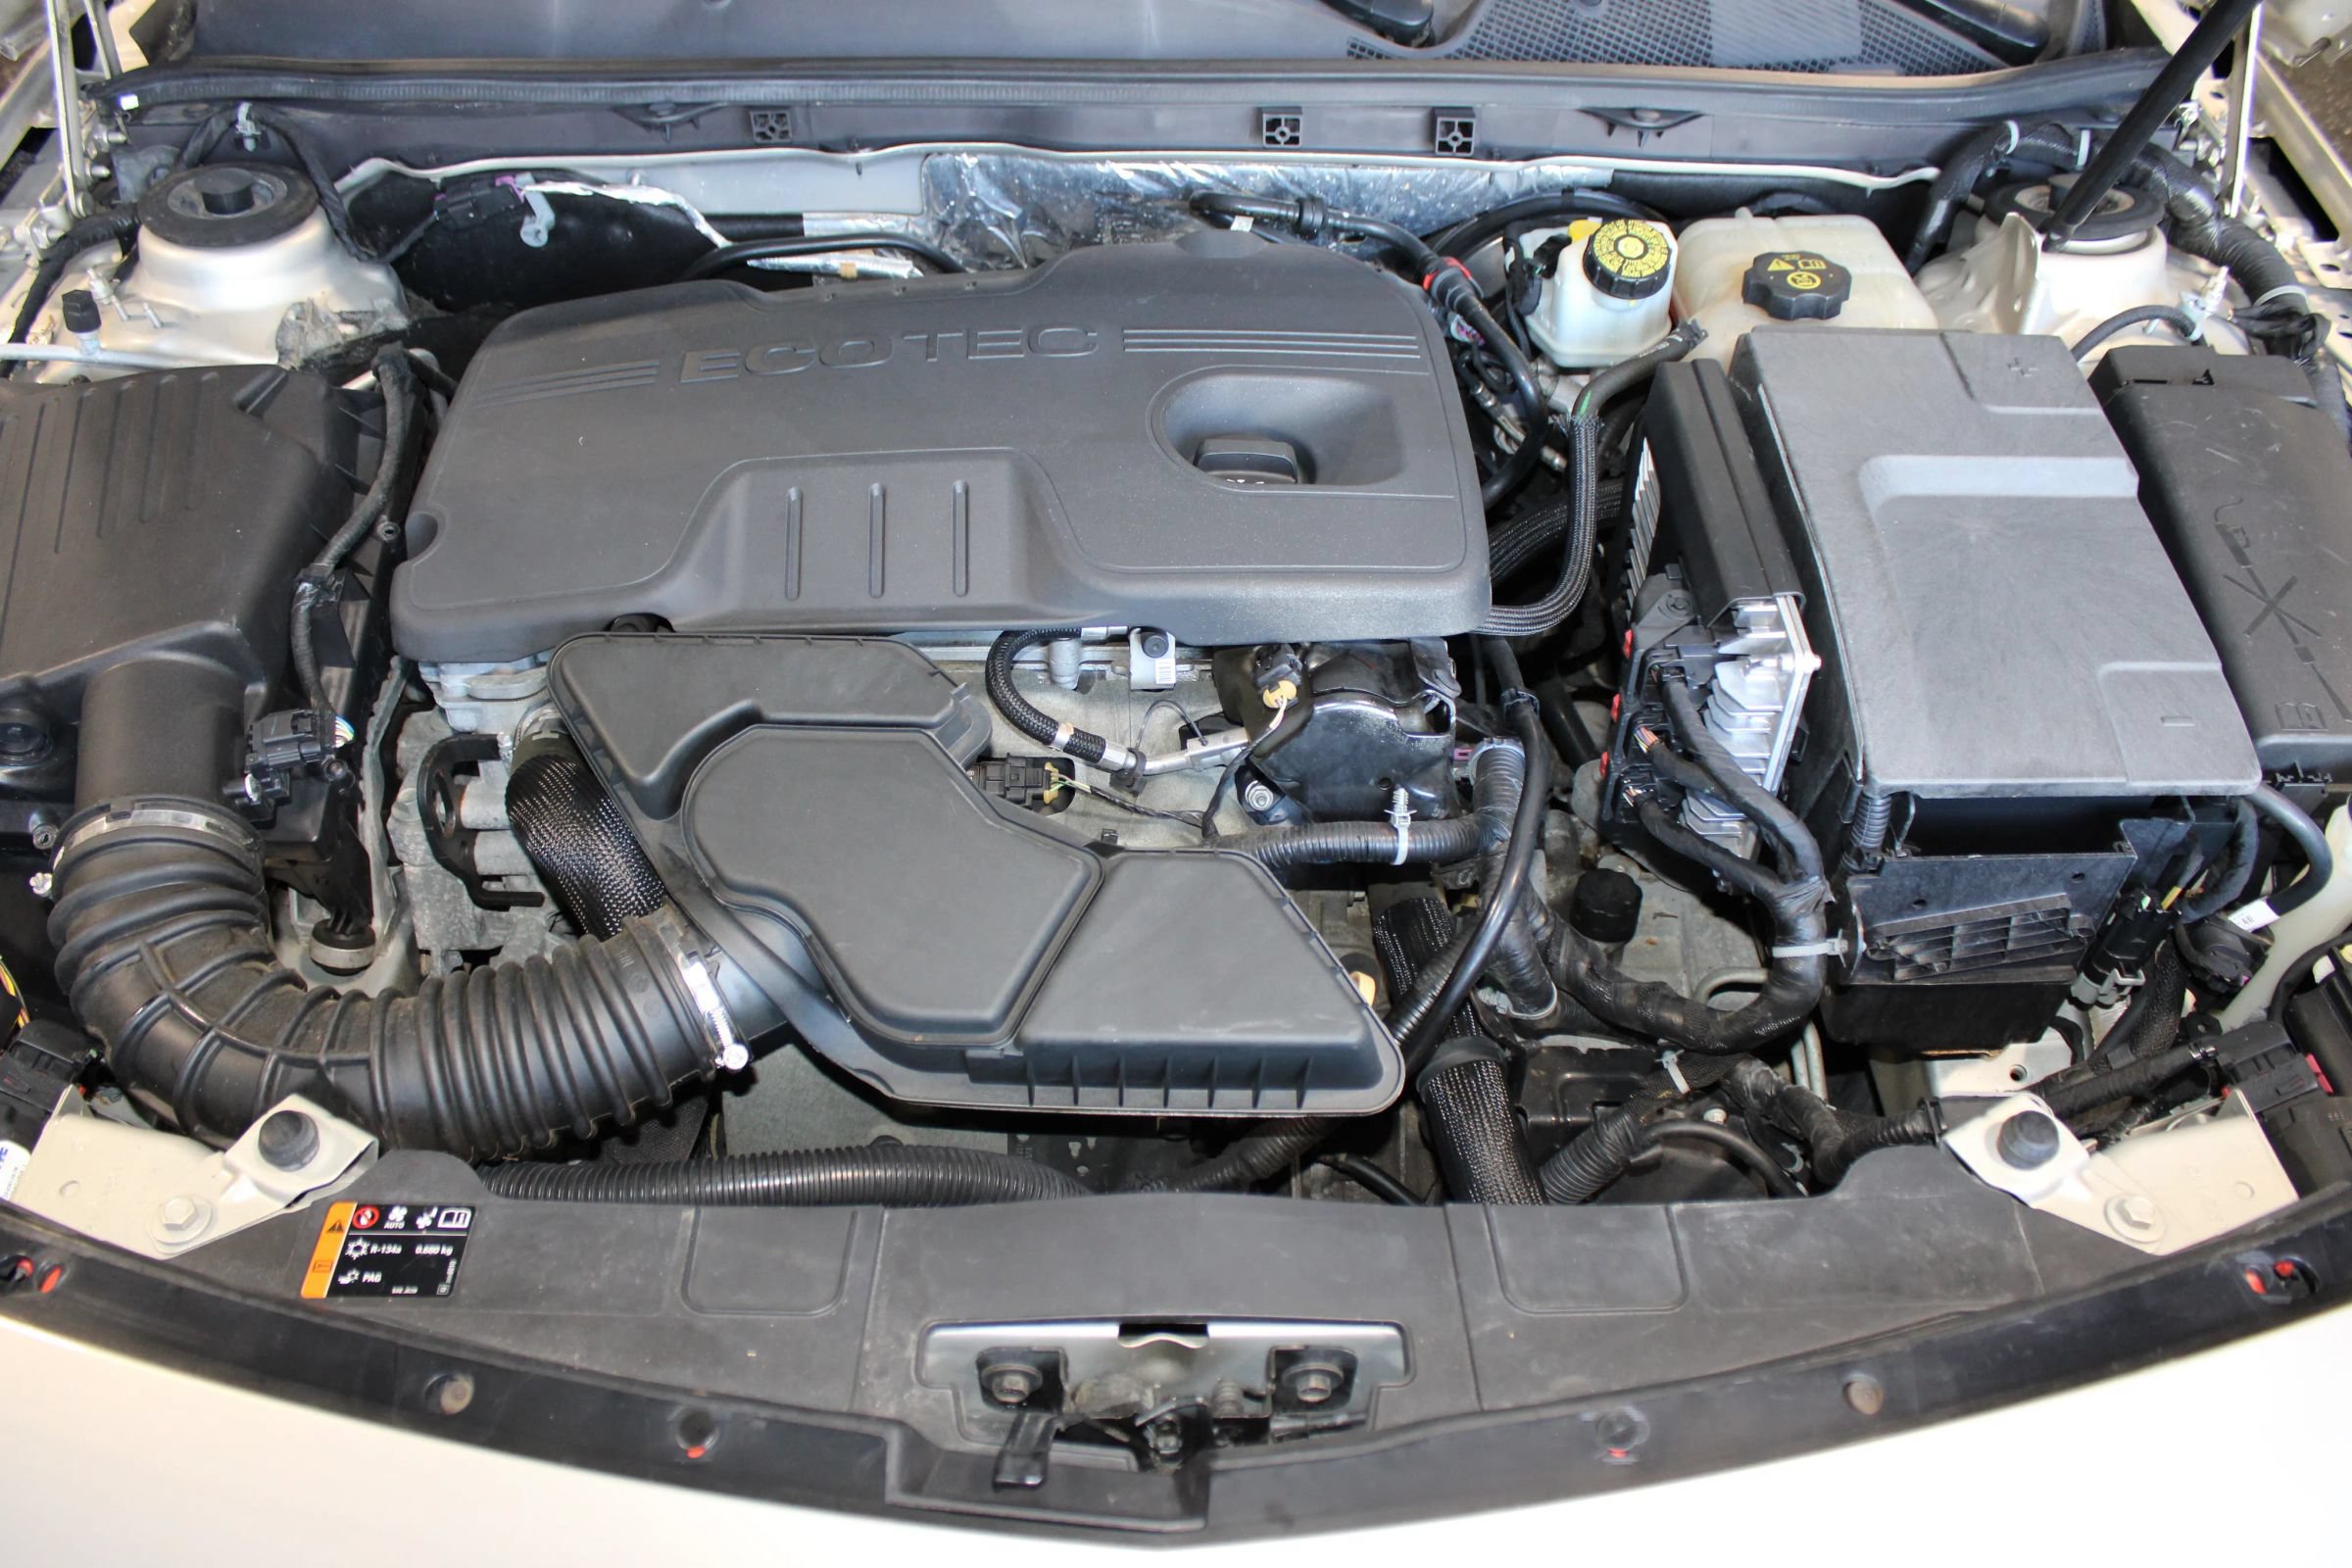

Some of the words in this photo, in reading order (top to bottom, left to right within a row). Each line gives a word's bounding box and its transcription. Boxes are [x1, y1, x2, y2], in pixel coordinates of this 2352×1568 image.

[679, 322, 1099, 383] ECOTEC
[369, 1243, 402, 1254] R-134a
[441, 1243, 454, 1256] kg
[362, 1271, 382, 1283] PAG
